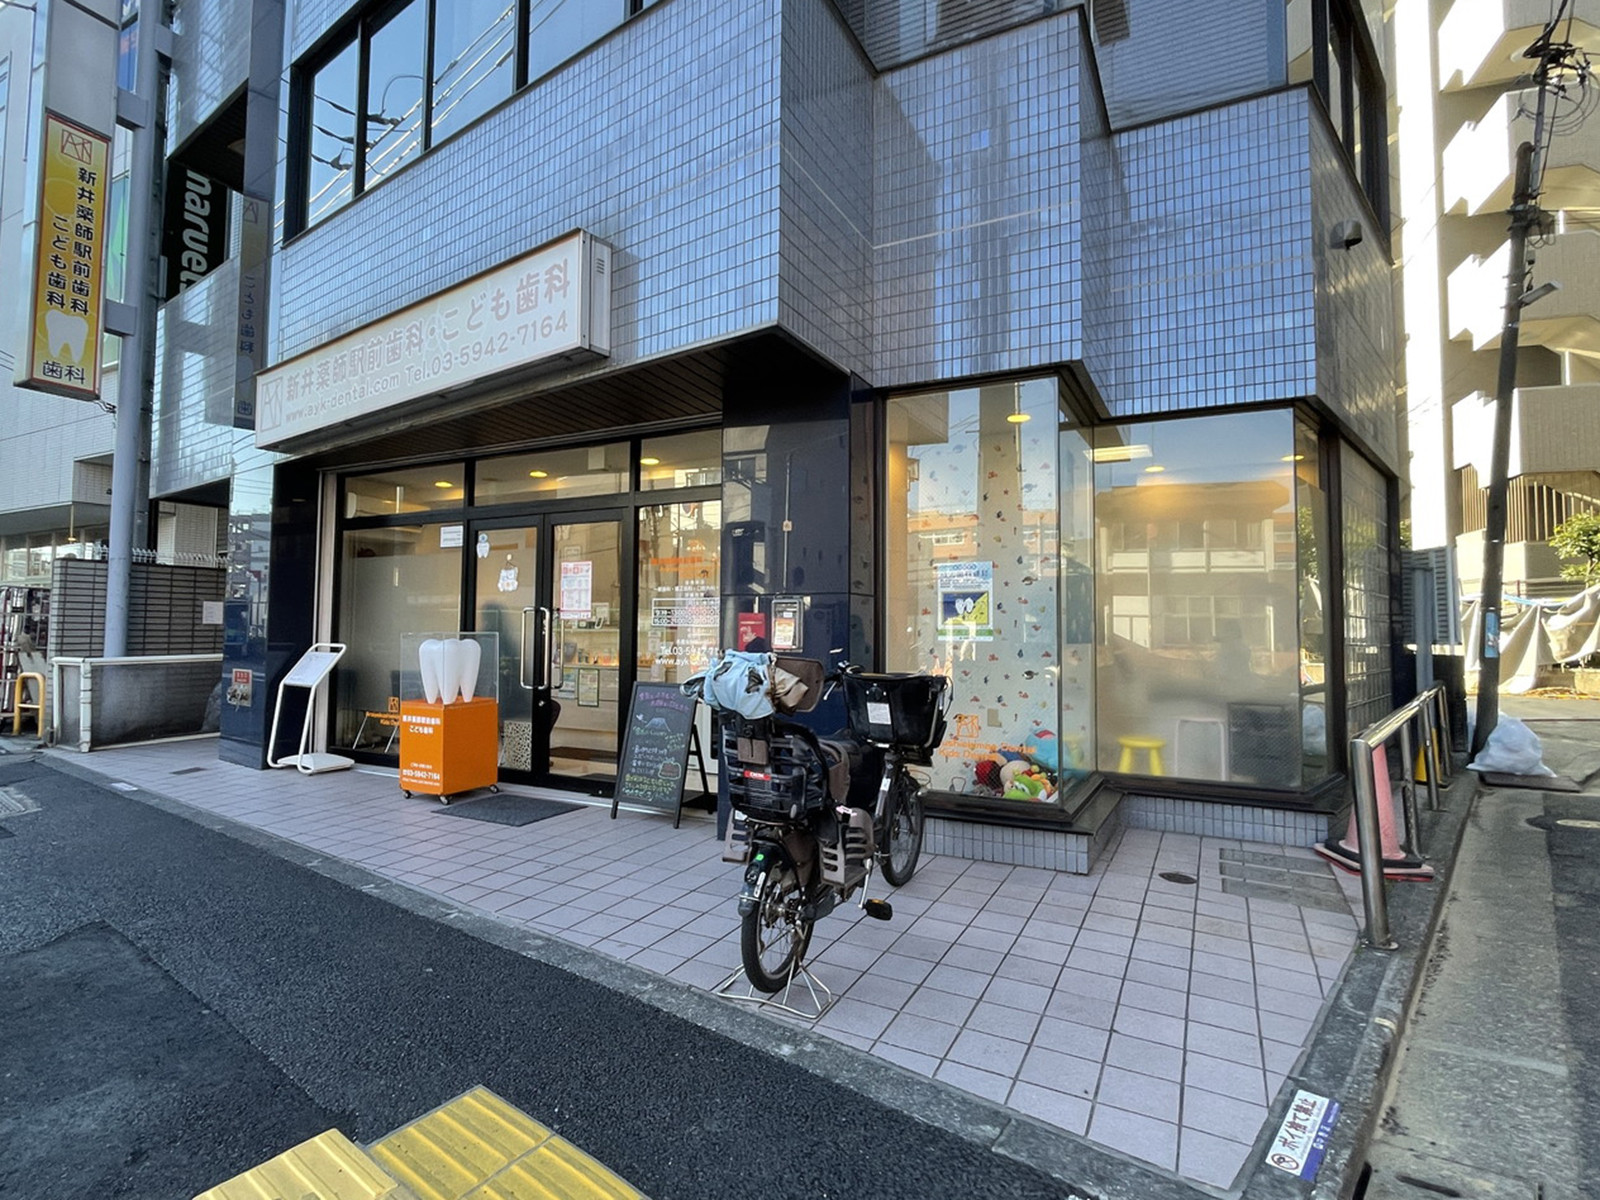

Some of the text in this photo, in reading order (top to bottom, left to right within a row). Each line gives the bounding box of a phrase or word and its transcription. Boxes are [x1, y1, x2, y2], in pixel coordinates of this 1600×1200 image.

[45, 214, 71, 311] こども歯科
[70, 166, 98, 317] 新井薬師駅前歯科
[41, 359, 87, 386] 歯科
